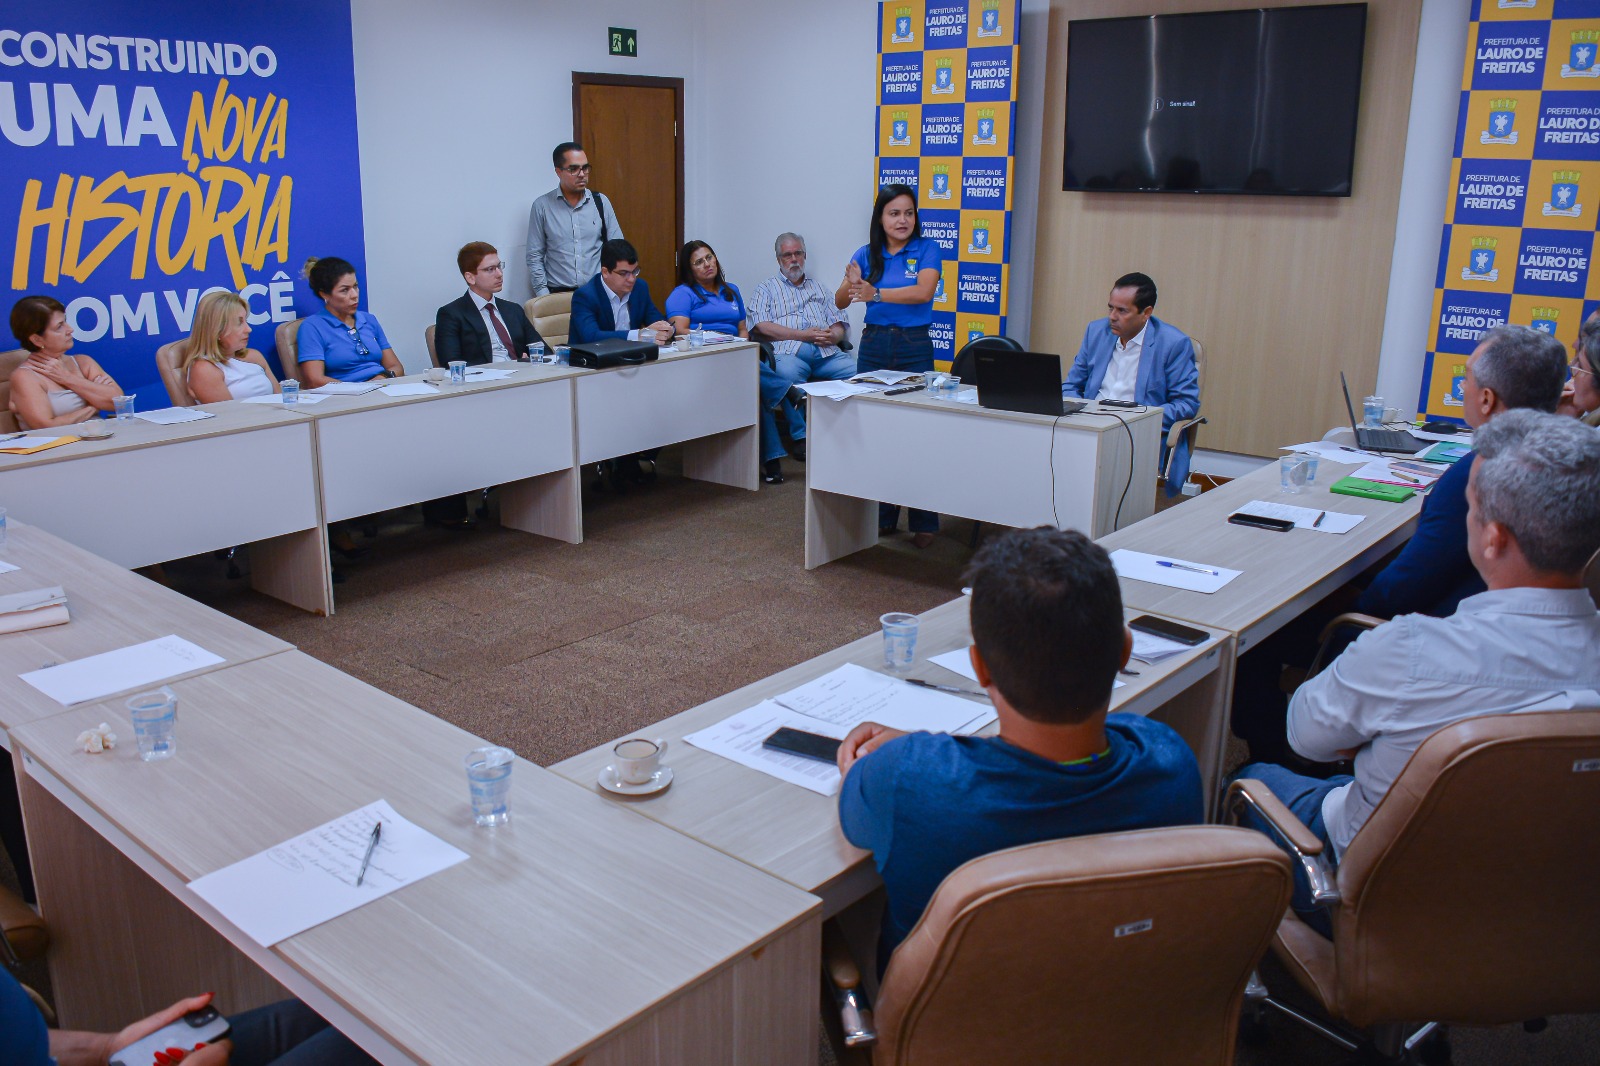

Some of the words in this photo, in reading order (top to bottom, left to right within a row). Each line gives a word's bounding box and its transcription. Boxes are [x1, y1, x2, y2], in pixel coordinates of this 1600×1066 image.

[926, 15, 954, 26] LAURO
[955, 14, 966, 24] DE
[930, 26, 962, 36] FREITAS
[0, 30, 278, 78] CONSTRUINDO
[1477, 48, 1523, 59] LAURO
[1525, 47, 1544, 59] DE
[1482, 62, 1535, 73] FREITAS
[883, 73, 909, 82] LAURO
[910, 72, 921, 81] DE
[968, 69, 995, 78] LAURO
[996, 68, 1010, 77] DE
[886, 83, 917, 92] FREITAS
[971, 79, 1005, 89] FREITAS
[0, 81, 177, 147] UMA
[182, 78, 288, 163] NOVA
[1540, 117, 1588, 129] LAURO
[1589, 118, 1600, 129] D
[923, 125, 949, 133] LAURO
[951, 124, 962, 133] DE
[926, 135, 958, 144] FREITAS
[1544, 132, 1599, 143] FREITAS
[907, 177, 917, 185] DE
[963, 177, 991, 186] LAURO
[993, 178, 1004, 187] DE
[967, 188, 1000, 197] FREITAS
[1459, 184, 1504, 196] LAURO
[1506, 185, 1524, 196] DE
[1464, 198, 1516, 210] FREITAS
[921, 229, 946, 238] AURO
[947, 230, 957, 238] DE
[1527, 246, 1571, 254] PREFEITURA
[1520, 255, 1566, 268] LAURO
[1568, 258, 1587, 270] DE
[1524, 269, 1578, 283] FREITAS
[959, 282, 986, 291] LAURO
[988, 283, 999, 292] DE
[962, 293, 994, 303] FREITAS
[64, 292, 160, 342] OM
[163, 271, 296, 332] VCÊ
[1448, 306, 1490, 315] PREFEITURA
[1441, 314, 1485, 327] LAURO
[943, 331, 953, 340] DE
[1446, 328, 1486, 340] FREIT
